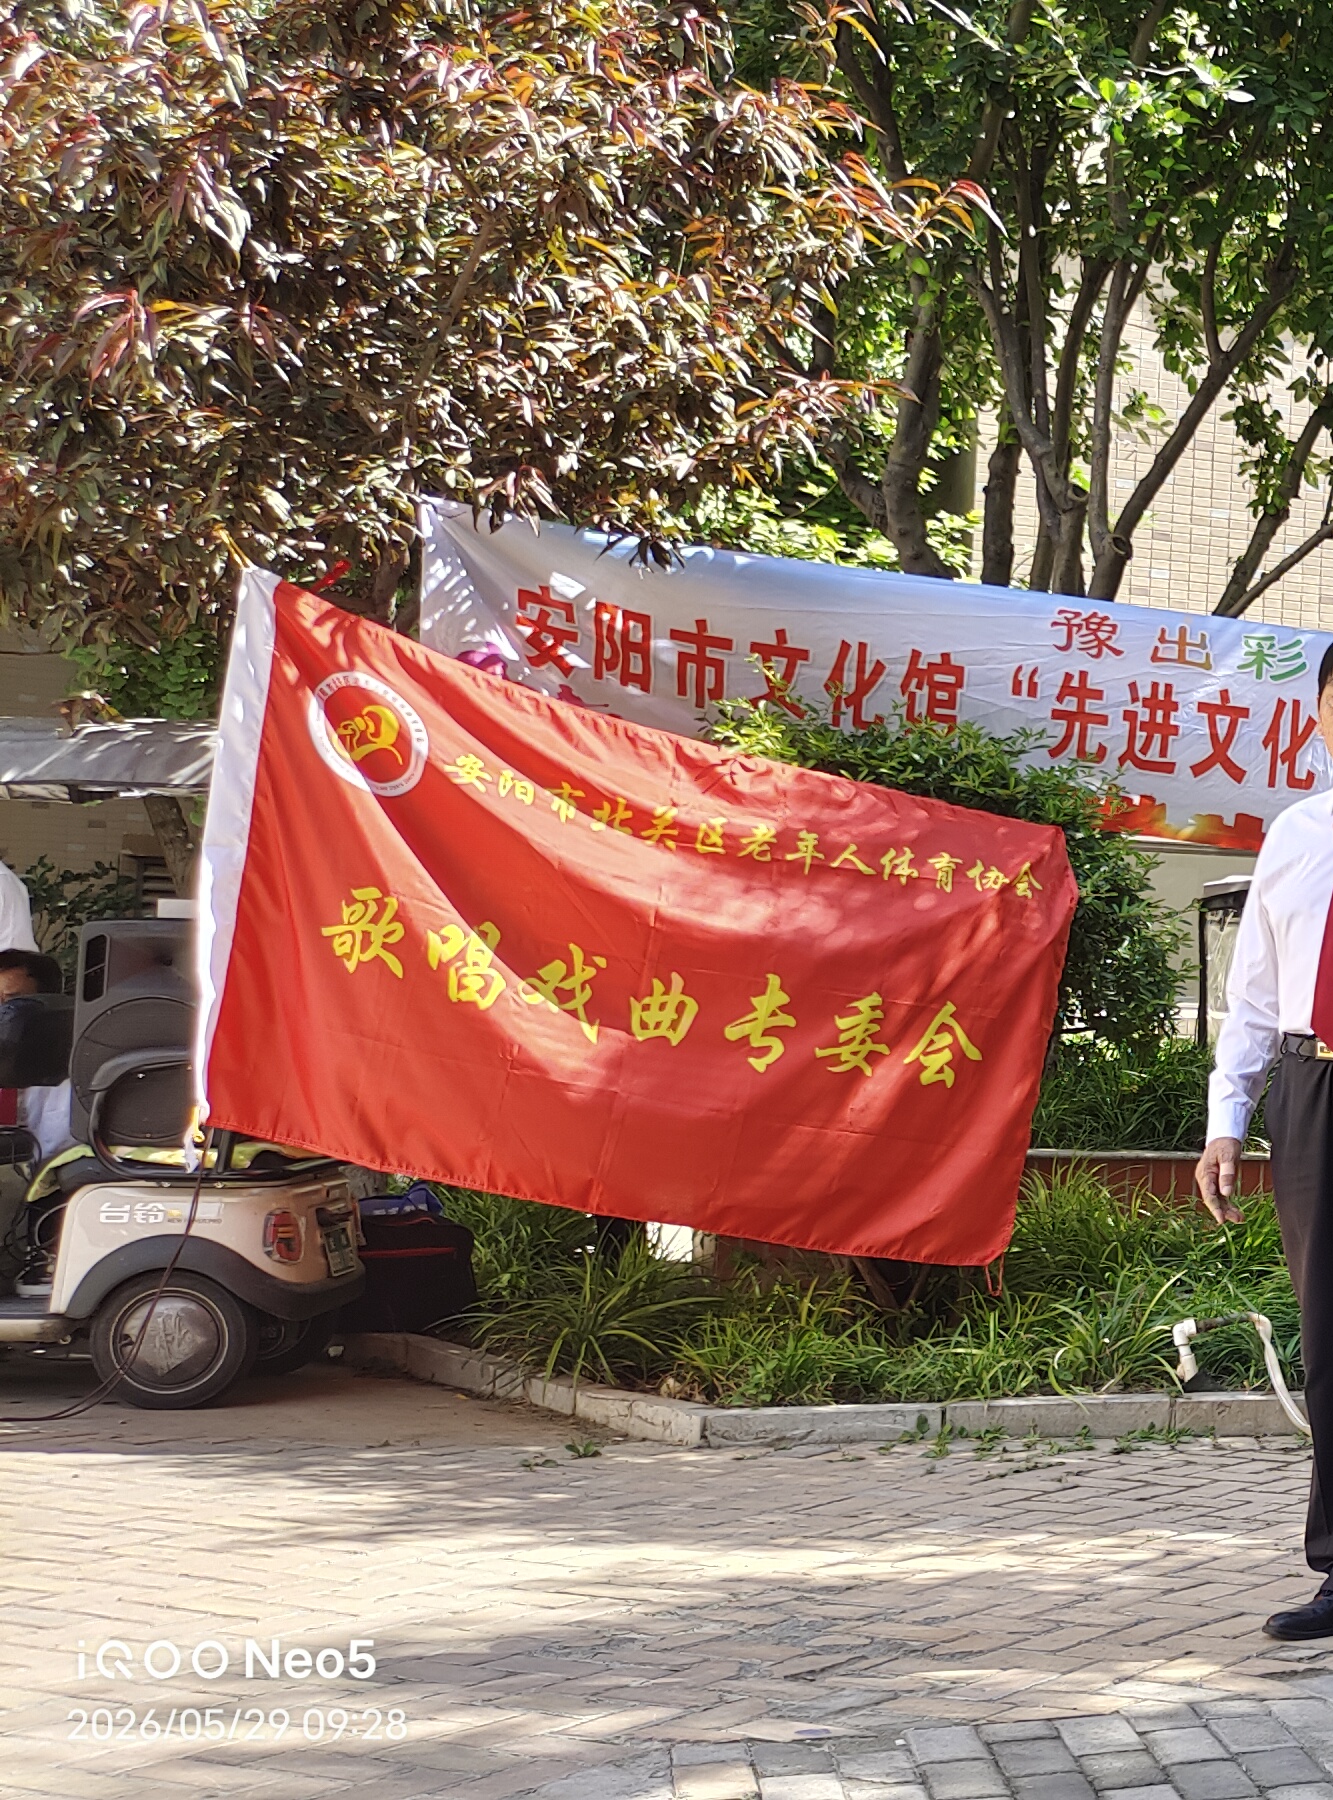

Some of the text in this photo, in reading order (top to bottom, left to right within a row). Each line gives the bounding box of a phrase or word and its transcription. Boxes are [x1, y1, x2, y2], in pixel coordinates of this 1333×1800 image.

[445, 754, 1043, 900] 安阳市北关区老年人体育协会
[321, 888, 983, 1088] 歌唱戏曲专委会
[99, 1202, 166, 1224] 台铃
